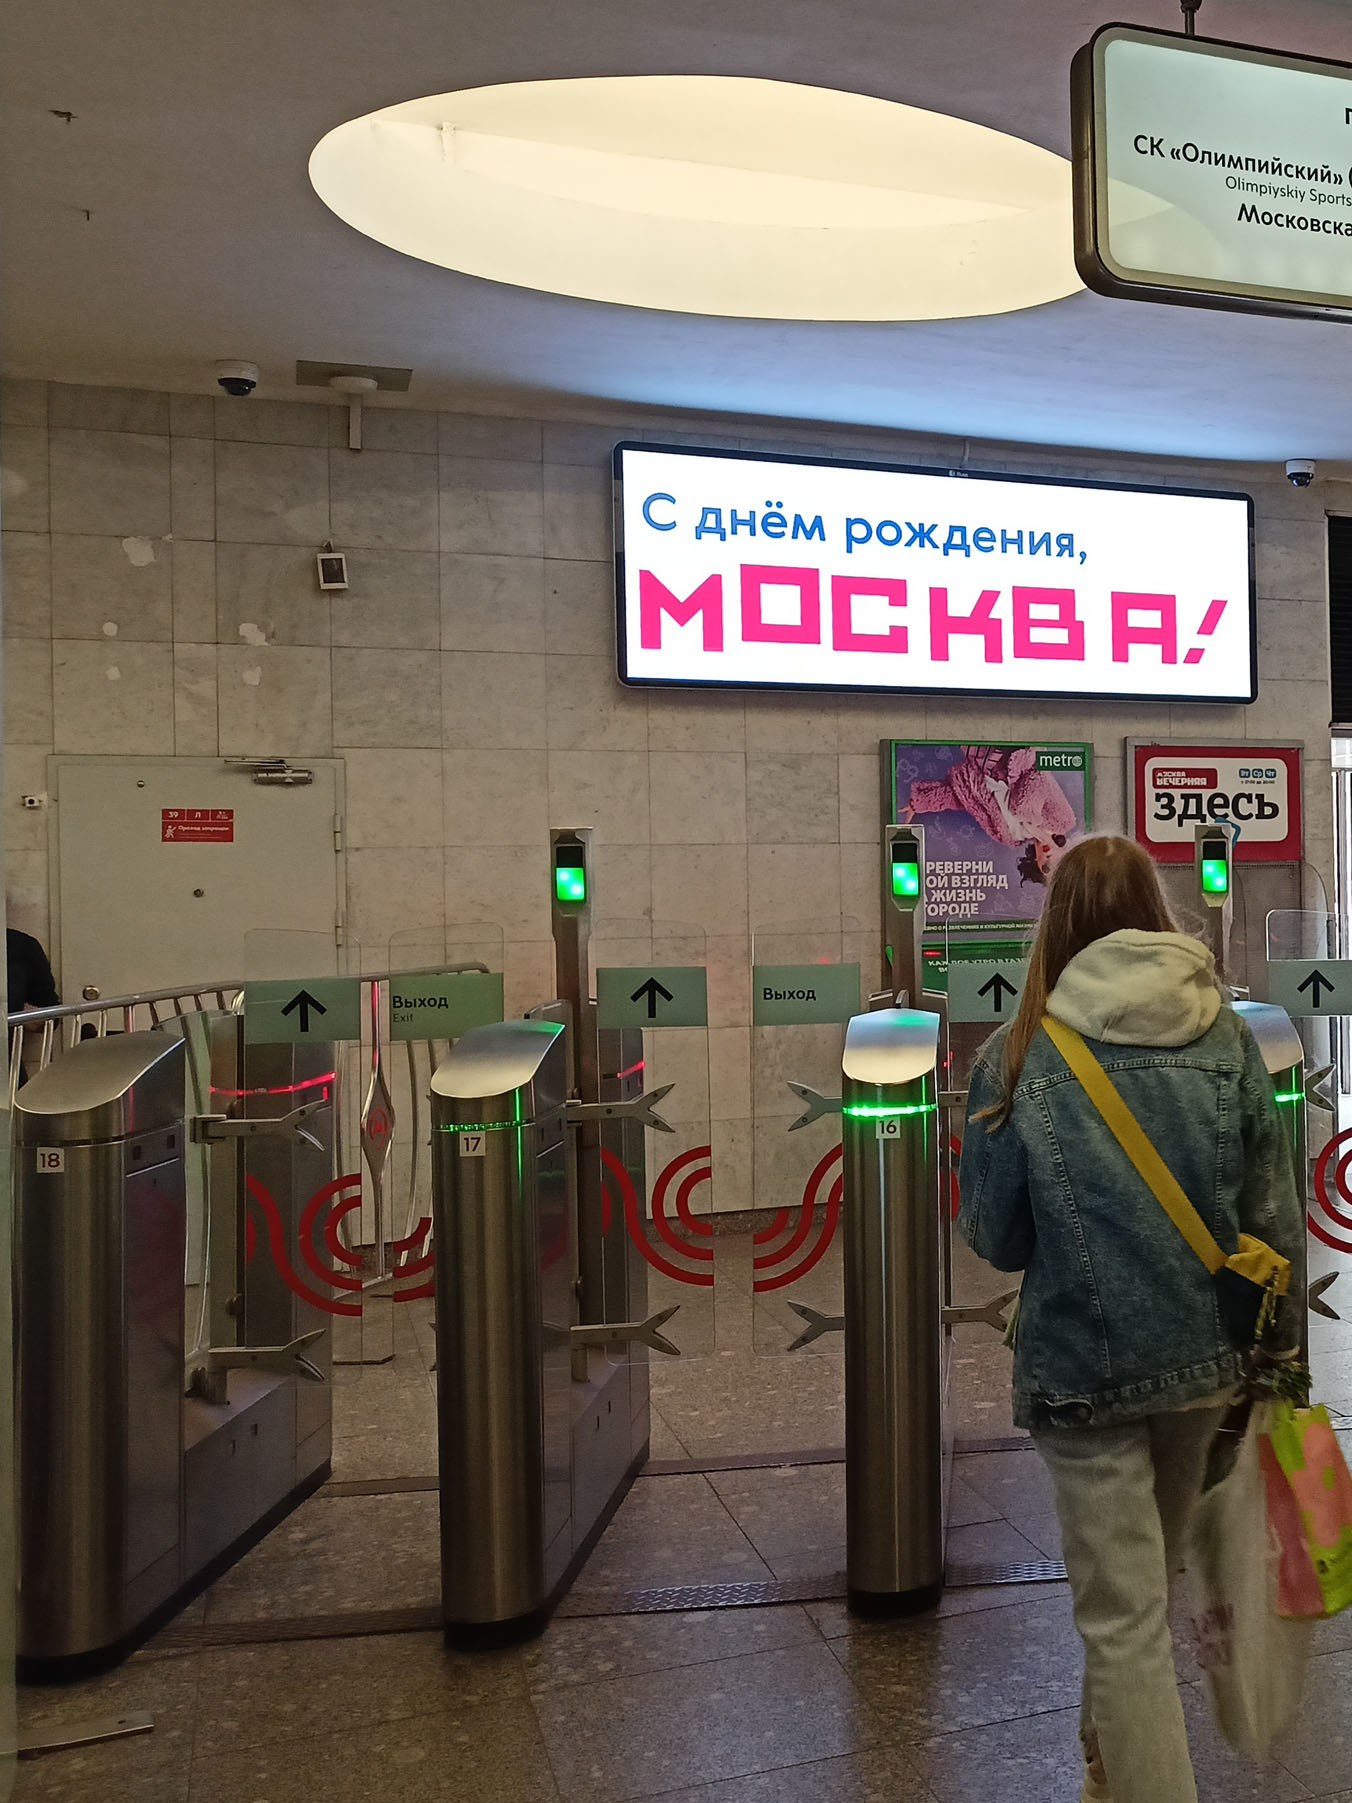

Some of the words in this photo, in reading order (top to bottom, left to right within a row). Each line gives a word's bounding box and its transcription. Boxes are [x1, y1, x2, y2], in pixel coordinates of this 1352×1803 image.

[1133, 134, 1165, 158] СК
[1170, 142, 1343, 185] «Олимпийский»
[1225, 175, 1306, 203] Olimpiyskiy
[1309, 188, 1352, 207] Sports
[641, 491, 678, 532] С
[694, 499, 827, 543] днём
[845, 514, 1088, 565] рождения,
[638, 563, 1229, 665] МОСКВА!
[1039, 753, 1083, 768] metro
[926, 860, 993, 874] РЕВЕРНИ
[926, 872, 948, 888] ОЙ
[951, 874, 1009, 890] ВЗГЛЯД
[931, 888, 986, 902] ЖИЗНЬ
[763, 987, 816, 1001] Выход
[392, 995, 448, 1009] Выход
[393, 1012, 413, 1022] Exit
[880, 1120, 897, 1134] 16
[463, 1136, 481, 1152] 17
[40, 1152, 60, 1168] 18
